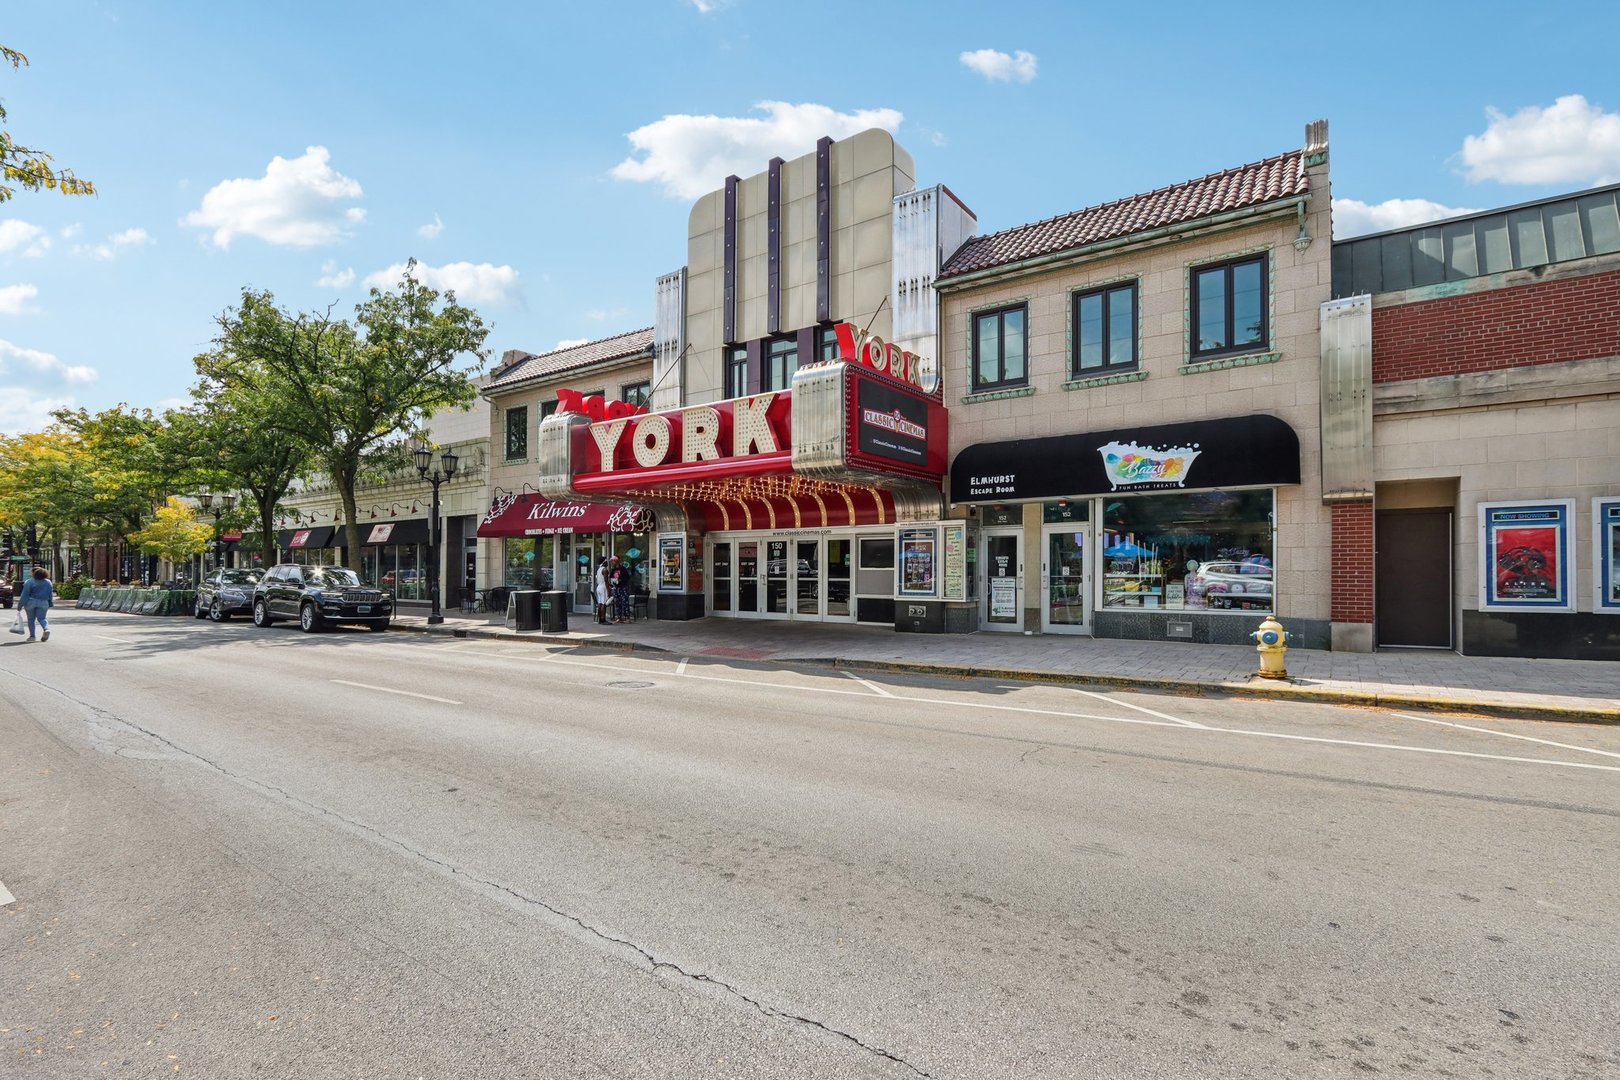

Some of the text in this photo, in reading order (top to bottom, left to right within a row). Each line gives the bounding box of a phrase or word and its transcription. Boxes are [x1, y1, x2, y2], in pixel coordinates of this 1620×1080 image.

[834, 322, 922, 388] YORK
[865, 411, 925, 438] CLASSIC CINEMAS
[588, 393, 779, 473] YORK
[1121, 460, 1167, 479] Bazzy
[970, 474, 1015, 486] ELMHURST
[970, 486, 1015, 495] ESCAPE ROOM
[772, 529, 832, 537] www.classiccinemas.com
[771, 542, 783, 550] 150
